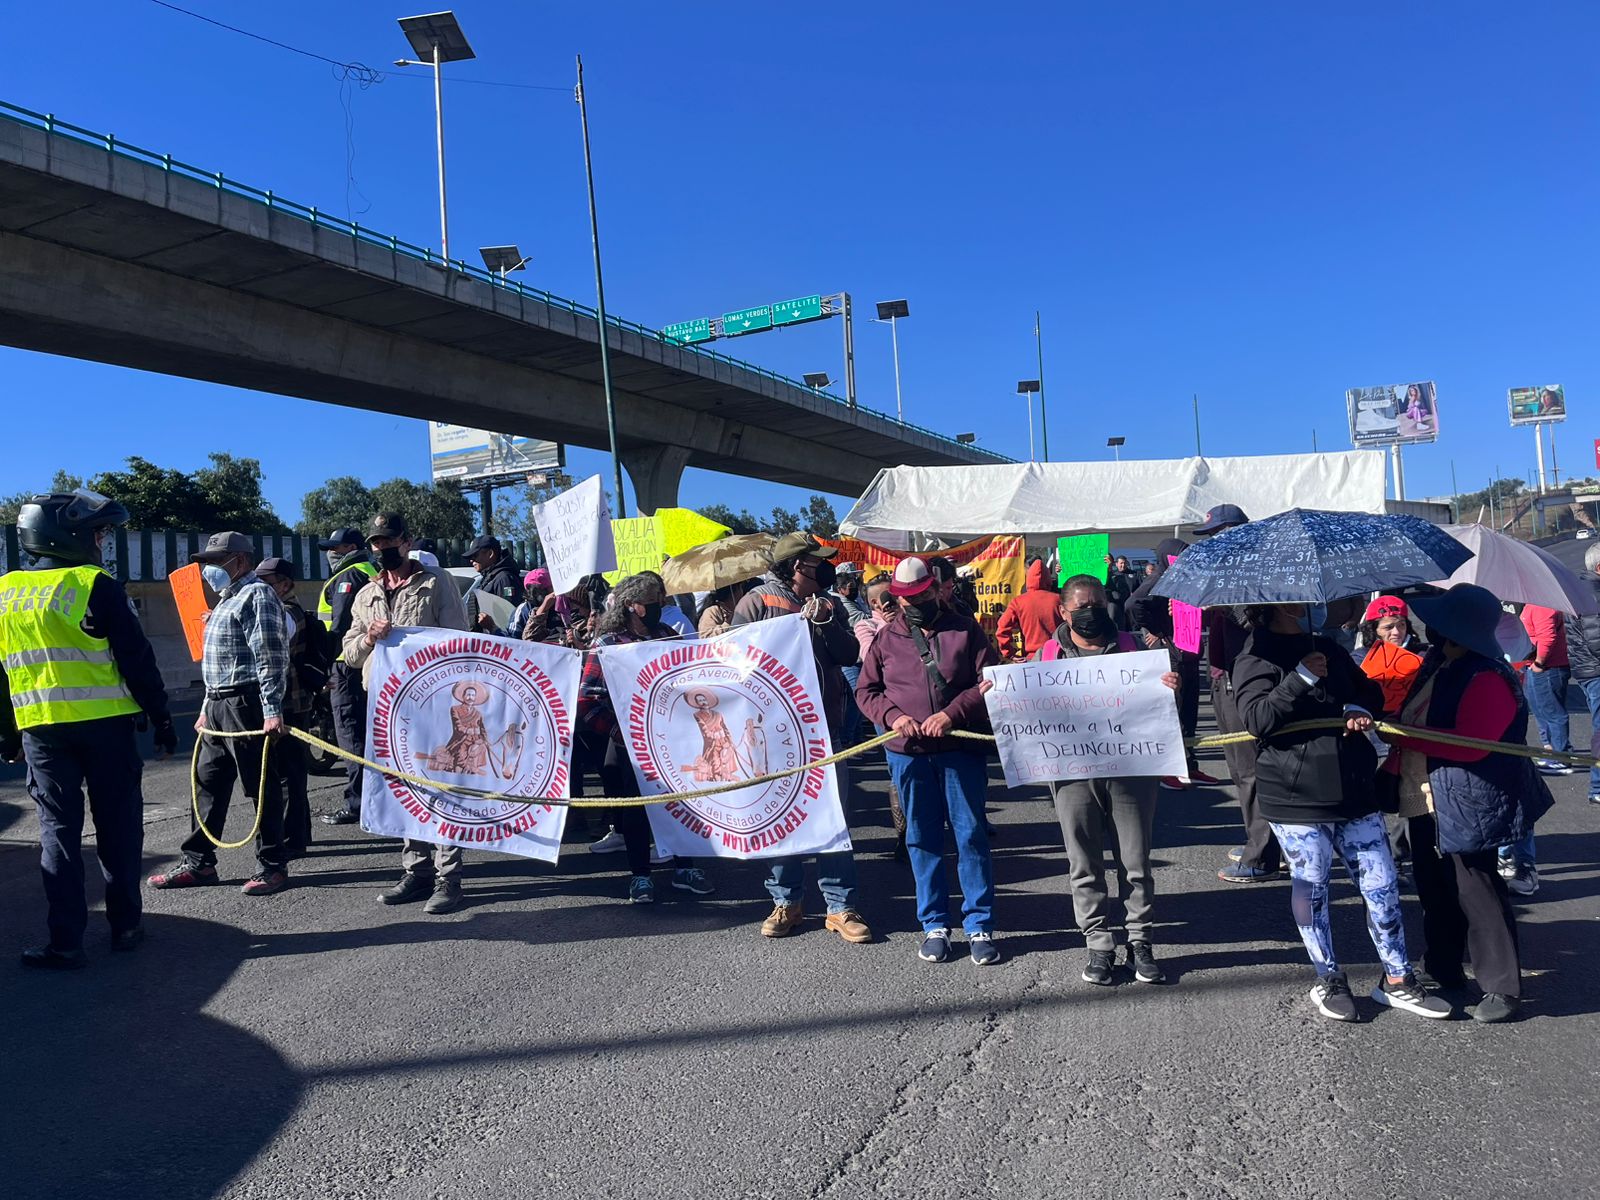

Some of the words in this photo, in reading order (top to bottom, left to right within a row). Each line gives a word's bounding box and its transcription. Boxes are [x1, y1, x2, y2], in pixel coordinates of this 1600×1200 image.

[775, 297, 817, 311] SATELITE
[668, 319, 706, 331] VALLEJO
[724, 313, 744, 323] LOMAS
[746, 308, 768, 318] VERDES
[695, 324, 706, 332] BAZ
[612, 518, 656, 541] ISCALIA
[1225, 555, 1241, 566] 31
[1295, 551, 1312, 562] 31
[1325, 546, 1342, 557] 31
[0, 597, 72, 617] STATAL
[405, 638, 514, 674] HUIXQUILUCAN
[1369, 640, 1422, 677] NO
[992, 669, 1017, 693] LA
[1023, 665, 1106, 689] FISCALIA
[1120, 669, 1142, 686] DE
[409, 664, 471, 703] Ejidatarios
[475, 663, 540, 719] Avecindados
[656, 674, 694, 716] Ejidatarios
[520, 658, 571, 748] TEYAHUALCO
[372, 672, 402, 758] NAUCALPAN
[400, 716, 411, 725] y
[629, 693, 660, 782] NAUCALPAN
[656, 732, 666, 741] y
[1001, 719, 1077, 741] apadrina
[1087, 723, 1098, 734] a
[1107, 718, 1125, 735] la
[1037, 740, 1167, 760] DELINCUENTE
[400, 728, 428, 795] comuneos
[1014, 760, 1061, 781] Elena
[660, 744, 703, 808] comuneos
[429, 795, 448, 811] del
[451, 804, 497, 818] Estado
[500, 800, 516, 812] de
[706, 806, 723, 819] del
[764, 798, 780, 815] de
[661, 790, 714, 839] CHILPA
[725, 811, 763, 828] Estado
[437, 811, 538, 842] TEPOTZOTLAN
[722, 804, 808, 853] TEPOTZOTLAN
